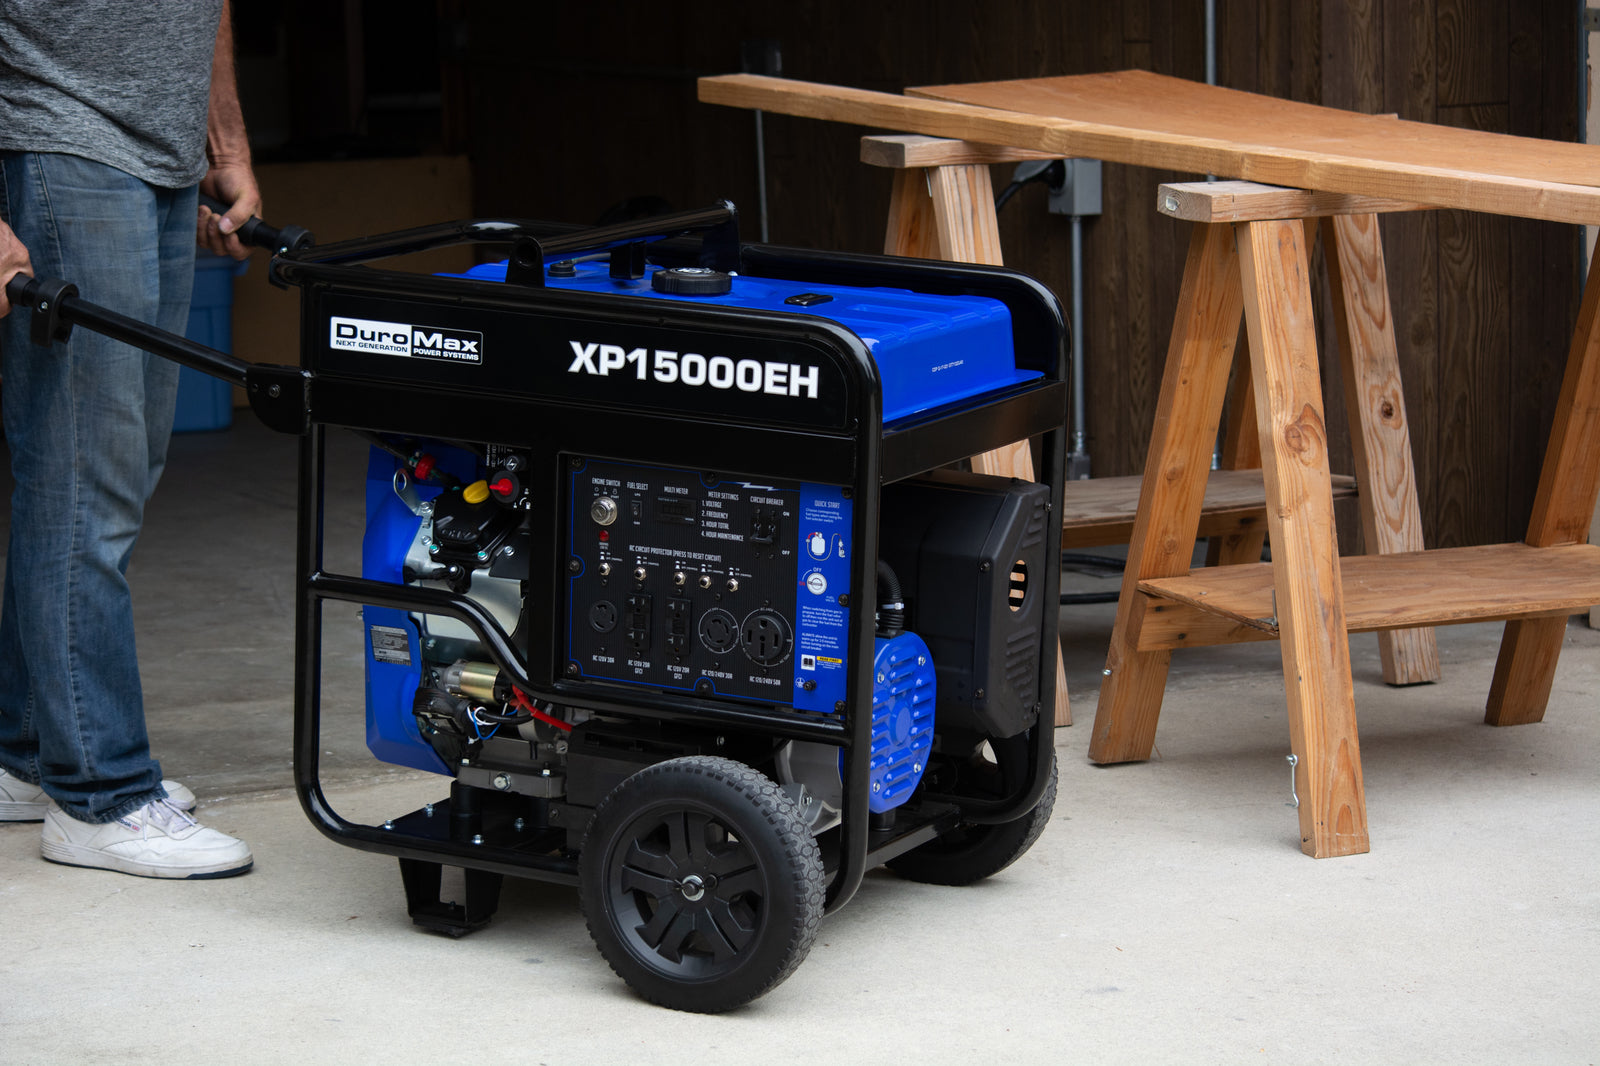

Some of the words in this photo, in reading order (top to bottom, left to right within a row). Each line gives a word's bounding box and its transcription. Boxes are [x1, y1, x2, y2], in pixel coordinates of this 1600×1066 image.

[358, 342, 408, 352] GENERATION
[413, 348, 441, 357] POWER
[443, 352, 479, 361] SYSTEMS
[568, 340, 819, 399] XP15000EH
[721, 492, 739, 500] SETTINGS
[766, 498, 783, 506] BREAKER
[706, 511, 728, 519] FREQUENCY
[718, 532, 744, 542] MAINTENANCE
[651, 547, 672, 556] PROTECTOR
[708, 670, 725, 678] 120/240V
[755, 676, 773, 685] 120/240V
